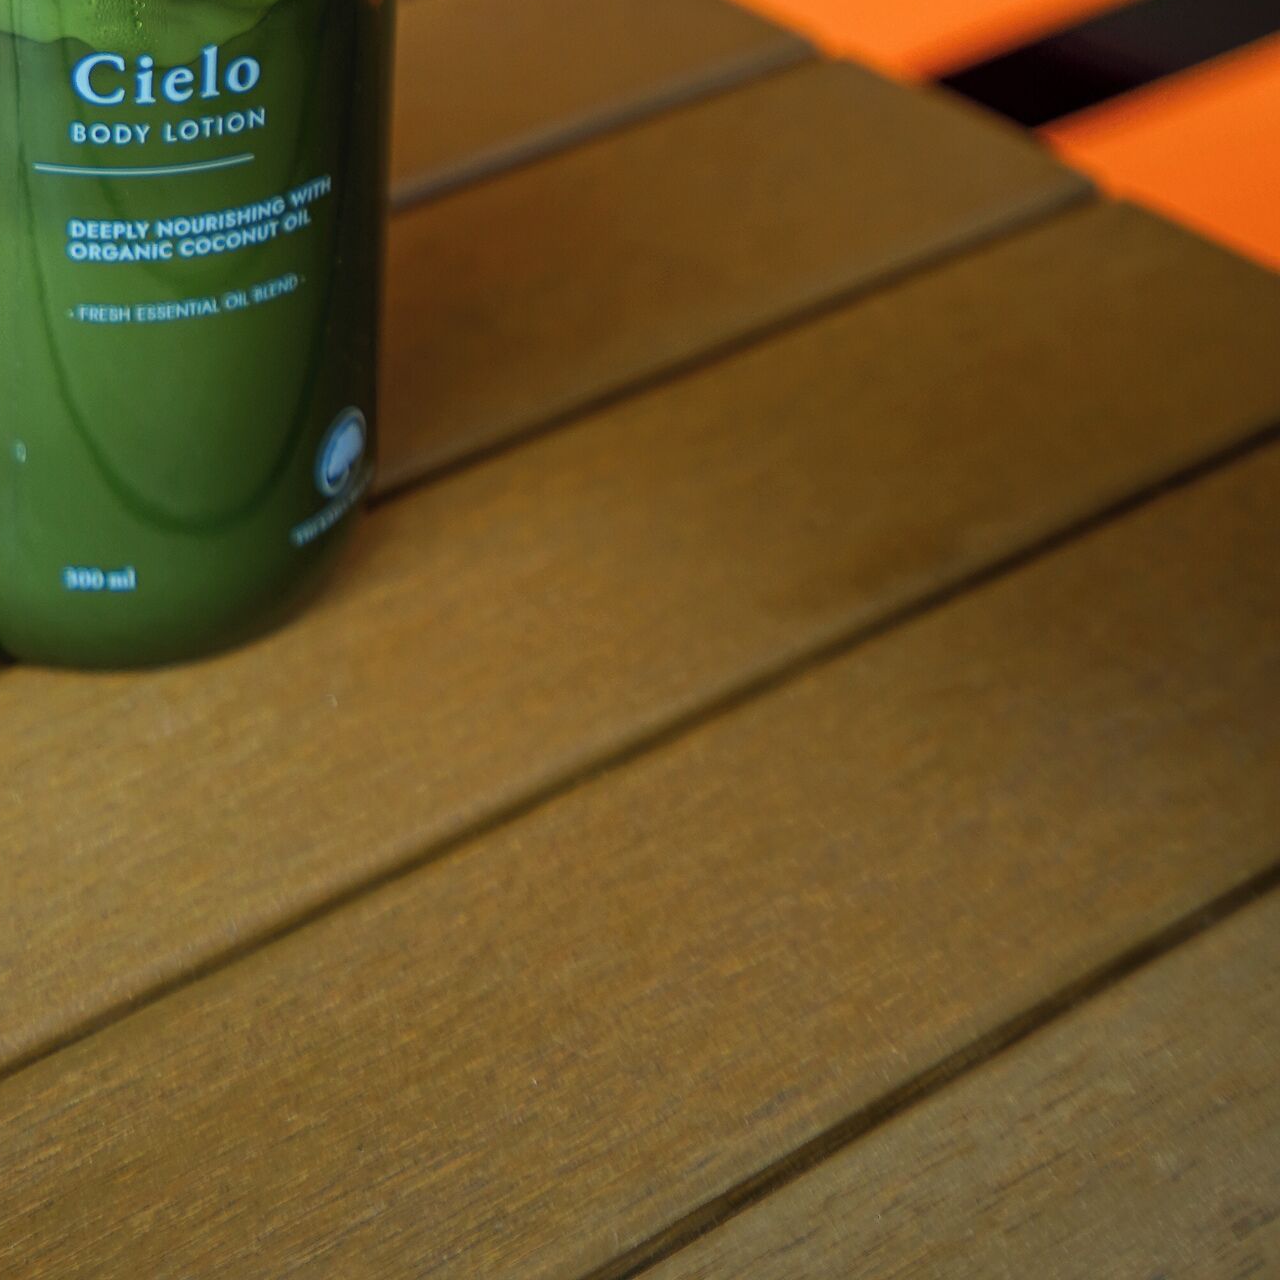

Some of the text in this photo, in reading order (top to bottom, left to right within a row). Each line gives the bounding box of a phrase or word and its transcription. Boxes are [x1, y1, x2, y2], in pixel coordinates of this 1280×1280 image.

[74, 46, 261, 104] Cielo
[72, 108, 266, 144] BODY LOTION
[71, 175, 331, 239] DEEPLY NOURISHING WITH
[70, 210, 311, 261] ORGANIC COCONUT OIL
[79, 306, 130, 321] FRESH
[137, 298, 219, 321] ESSENTIAL
[226, 290, 249, 309] OIL
[254, 275, 298, 300] BLEND
[108, 566, 136, 589] ml
